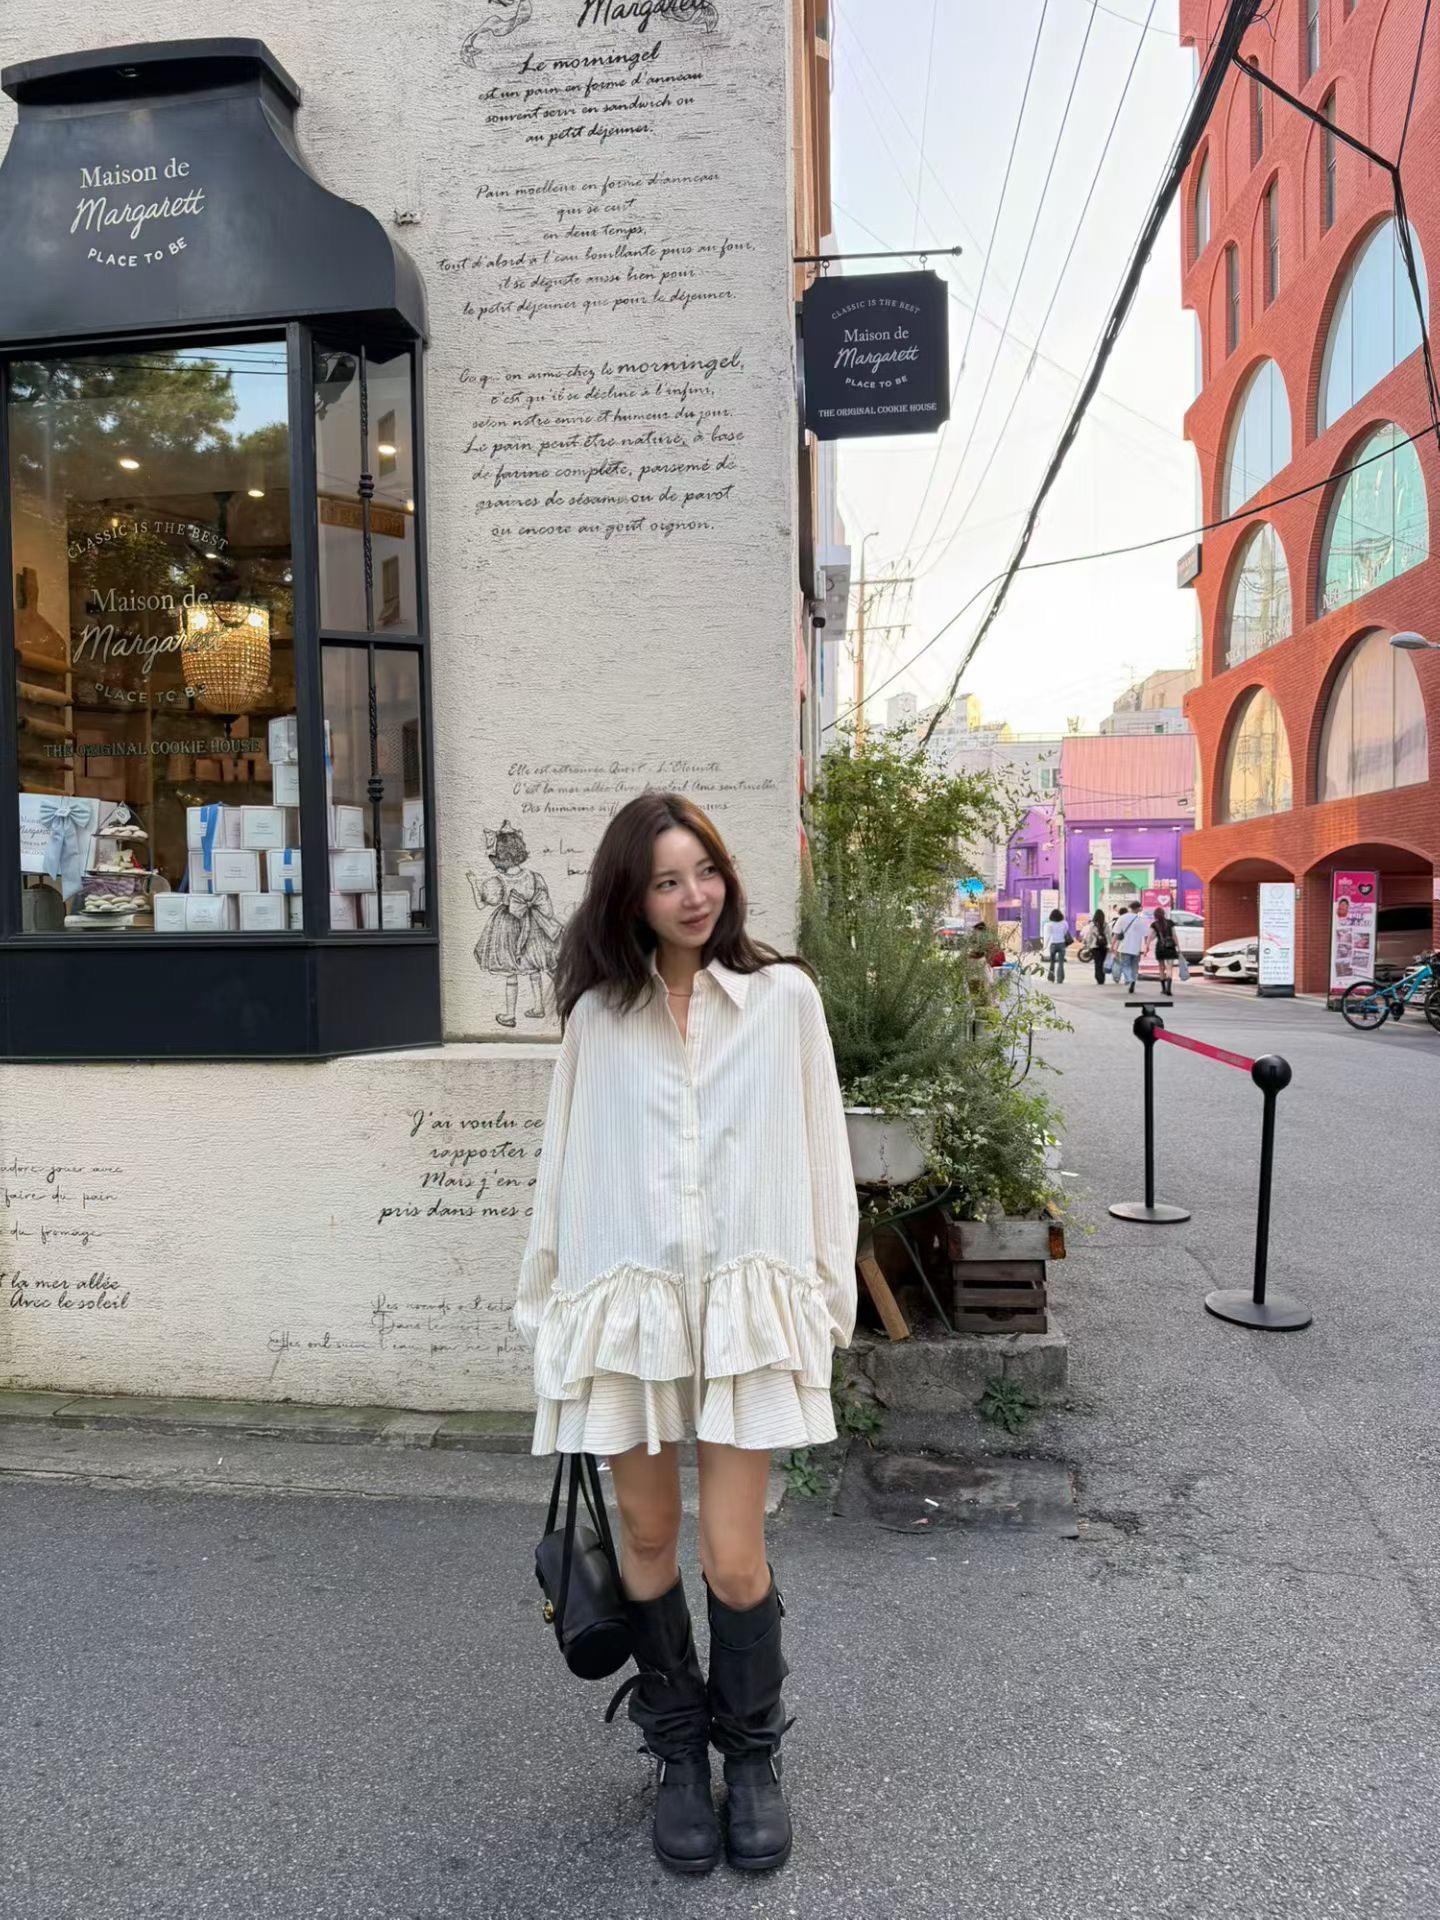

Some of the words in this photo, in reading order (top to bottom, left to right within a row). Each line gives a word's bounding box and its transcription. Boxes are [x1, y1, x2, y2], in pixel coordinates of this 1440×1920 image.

[518, 52, 547, 75] Le
[553, 40, 662, 71] morningel
[524, 86, 560, 102] pain
[583, 76, 627, 98] forme
[631, 71, 704, 87] d'anneau
[485, 106, 540, 124] souvent
[582, 104, 599, 114] en
[602, 93, 671, 113] sandwich
[676, 96, 695, 107] ou
[525, 133, 545, 144] au
[548, 125, 586, 147] petit
[79, 164, 158, 189] Maison
[163, 157, 190, 179] de
[476, 183, 509, 199] Pain
[582, 183, 598, 192] en
[600, 175, 644, 197] forme
[70, 187, 206, 240] Margarett
[543, 231, 559, 241] en
[87, 247, 138, 268] PLACE
[144, 250, 164, 265] TO
[168, 236, 188, 256] BE
[436, 257, 469, 271] tout
[472, 252, 527, 269] d'abord
[585, 244, 657, 261] bouillante
[659, 247, 692, 262] puis
[659, 269, 697, 286] pour
[463, 301, 475, 316] le
[478, 301, 516, 320] petit
[612, 297, 648, 312] pour
[653, 288, 666, 302] le
[831, 300, 866, 320] CLASSIC
[868, 299, 877, 307] IS
[879, 298, 898, 308] THE
[899, 299, 921, 316] BEST
[844, 328, 891, 344] Maison
[894, 325, 910, 340] de
[833, 344, 921, 374] Margarett
[566, 363, 596, 385] chez
[845, 377, 876, 389] PLACE
[879, 380, 893, 389] TO
[895, 375, 908, 386] BE
[674, 406, 697, 420] du
[818, 408, 836, 418] THE
[836, 406, 877, 417] ORIGINAL
[878, 404, 909, 415] COOKIE
[909, 402, 938, 414] HOUSE
[463, 434, 489, 454] Le
[489, 442, 533, 459] pain
[537, 434, 580, 458] peut
[711, 424, 746, 443] base
[471, 464, 492, 481] de
[494, 463, 550, 489] farine
[715, 454, 738, 471] de
[474, 494, 539, 516] graines
[544, 489, 565, 507] de
[631, 494, 654, 503] ou
[658, 485, 679, 502] de
[680, 484, 736, 509] pavot
[66, 524, 129, 560] CLASSIC
[134, 520, 149, 535] IS
[154, 520, 186, 536] THE
[191, 528, 230, 552] BEST
[491, 527, 512, 537] ou
[518, 525, 572, 535] encore
[578, 524, 601, 534] au
[91, 587, 176, 614] Maison
[182, 584, 209, 609] de
[72, 621, 229, 675] Margarett
[95, 682, 149, 704] PLACE
[155, 690, 177, 703] TO
[44, 743, 74, 758] THE
[76, 741, 148, 758] ORIGINAL
[151, 739, 206, 756] COOKIE
[210, 737, 262, 754] HOUSE
[409, 1108, 452, 1138] J'ai
[459, 1108, 518, 1130] voulu
[429, 1140, 526, 1168] rapporter
[92, 1166, 124, 1174] avec
[419, 1170, 475, 1189] Mais
[51, 1184, 73, 1205] du
[82, 1191, 119, 1210] pain
[376, 1200, 422, 1226] pris
[426, 1197, 477, 1218] dans
[482, 1205, 520, 1218] mes
[10, 1220, 34, 1241] du
[40, 1224, 105, 1247] fromage
[11, 1270, 30, 1291] la
[34, 1279, 70, 1290] mer
[76, 1271, 121, 1290] allée
[10, 1287, 52, 1309] Avec
[57, 1290, 75, 1310] le
[78, 1291, 132, 1311] soleil
